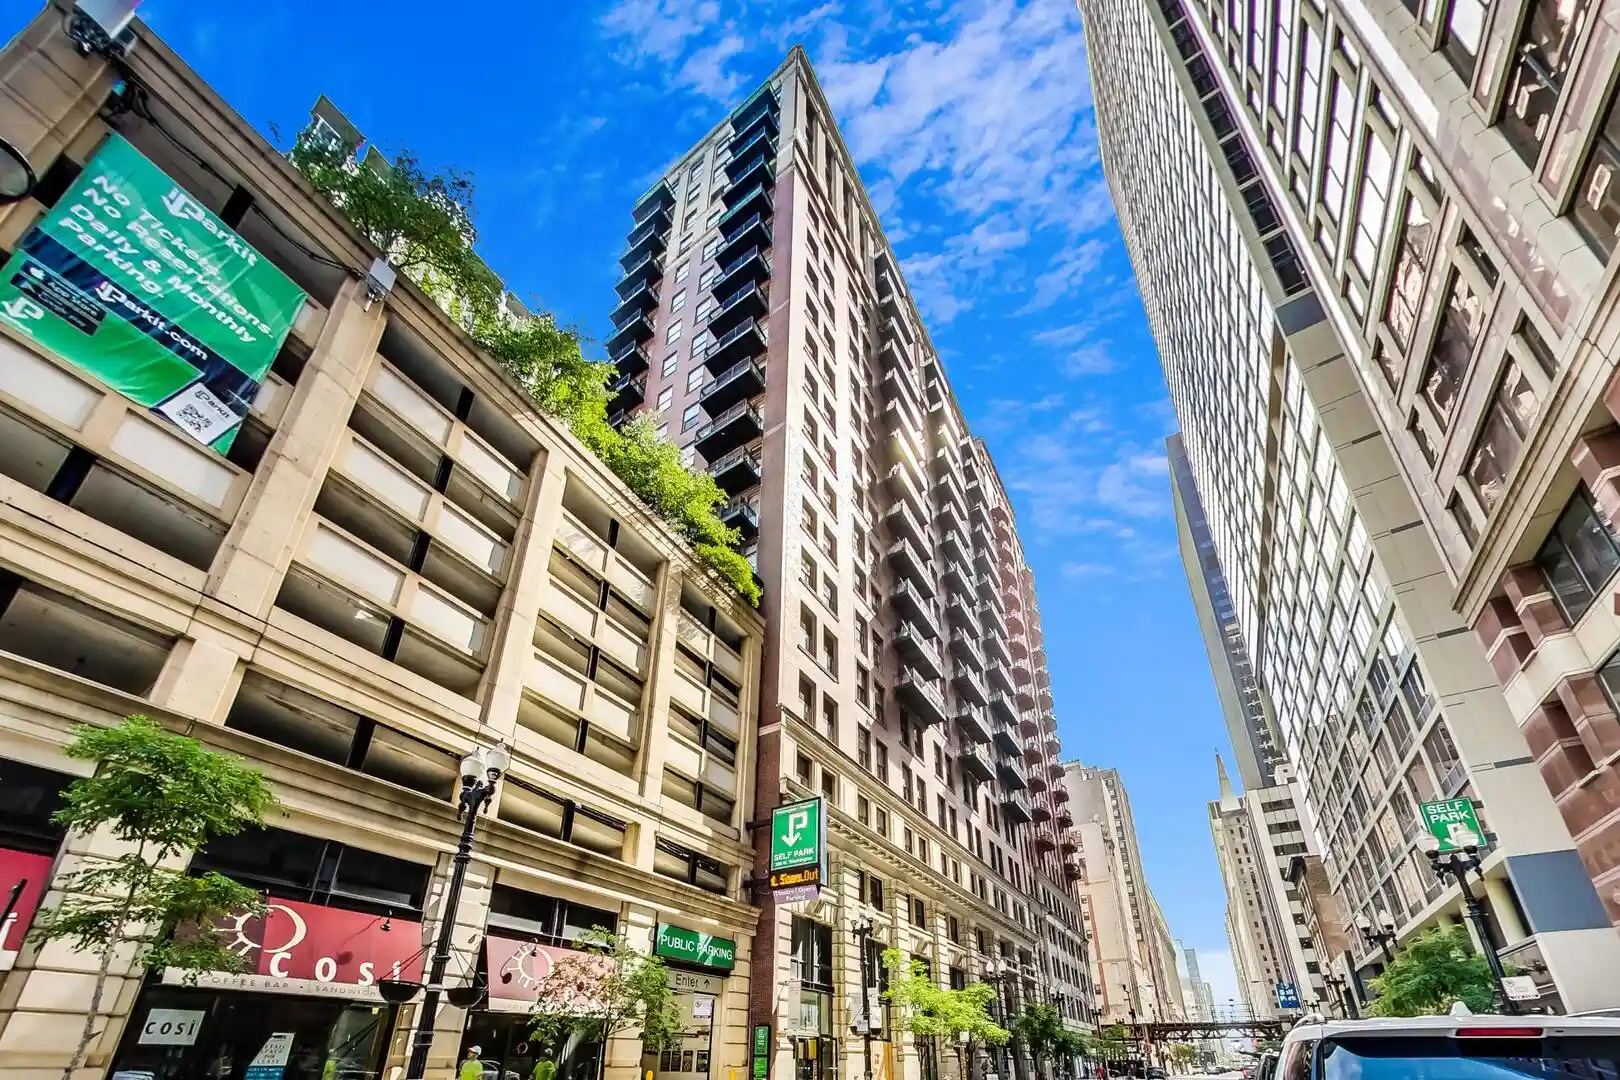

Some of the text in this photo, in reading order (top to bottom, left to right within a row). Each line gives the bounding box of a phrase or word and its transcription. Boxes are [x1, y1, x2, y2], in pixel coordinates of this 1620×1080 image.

[92, 175, 223, 281] No Tickets.
[58, 217, 164, 299] Parking.
[82, 188, 121, 219] No
[126, 220, 274, 339] Reservations.
[70, 203, 256, 342] Daily & Monthly
[1426, 801, 1464, 815] SELF
[1429, 810, 1472, 824] PARK
[774, 846, 815, 861] SELF PARK
[660, 935, 733, 960] PUBLIC PARKING
[201, 974, 257, 988] COFFEE
[264, 980, 290, 989] BAR
[675, 973, 699, 988] Enter
